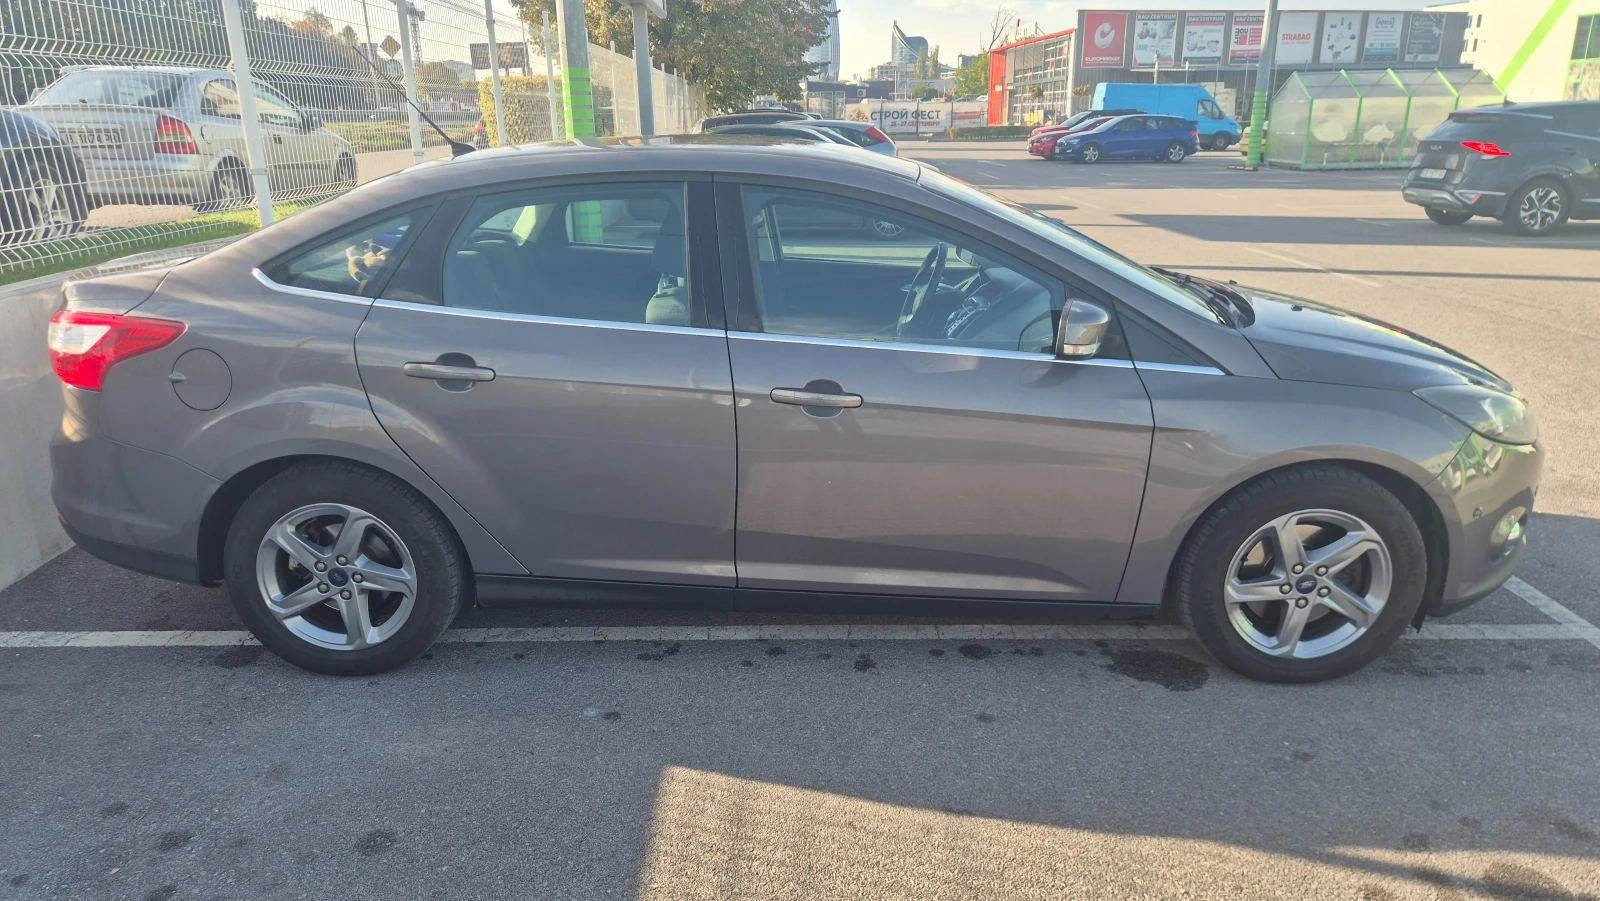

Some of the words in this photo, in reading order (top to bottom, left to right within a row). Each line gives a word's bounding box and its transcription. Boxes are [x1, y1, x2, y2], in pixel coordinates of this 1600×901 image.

[1282, 33, 1311, 41] STRABAG
[870, 108, 908, 121] СТРОЙ
[911, 109, 941, 120] ФЕСТ
